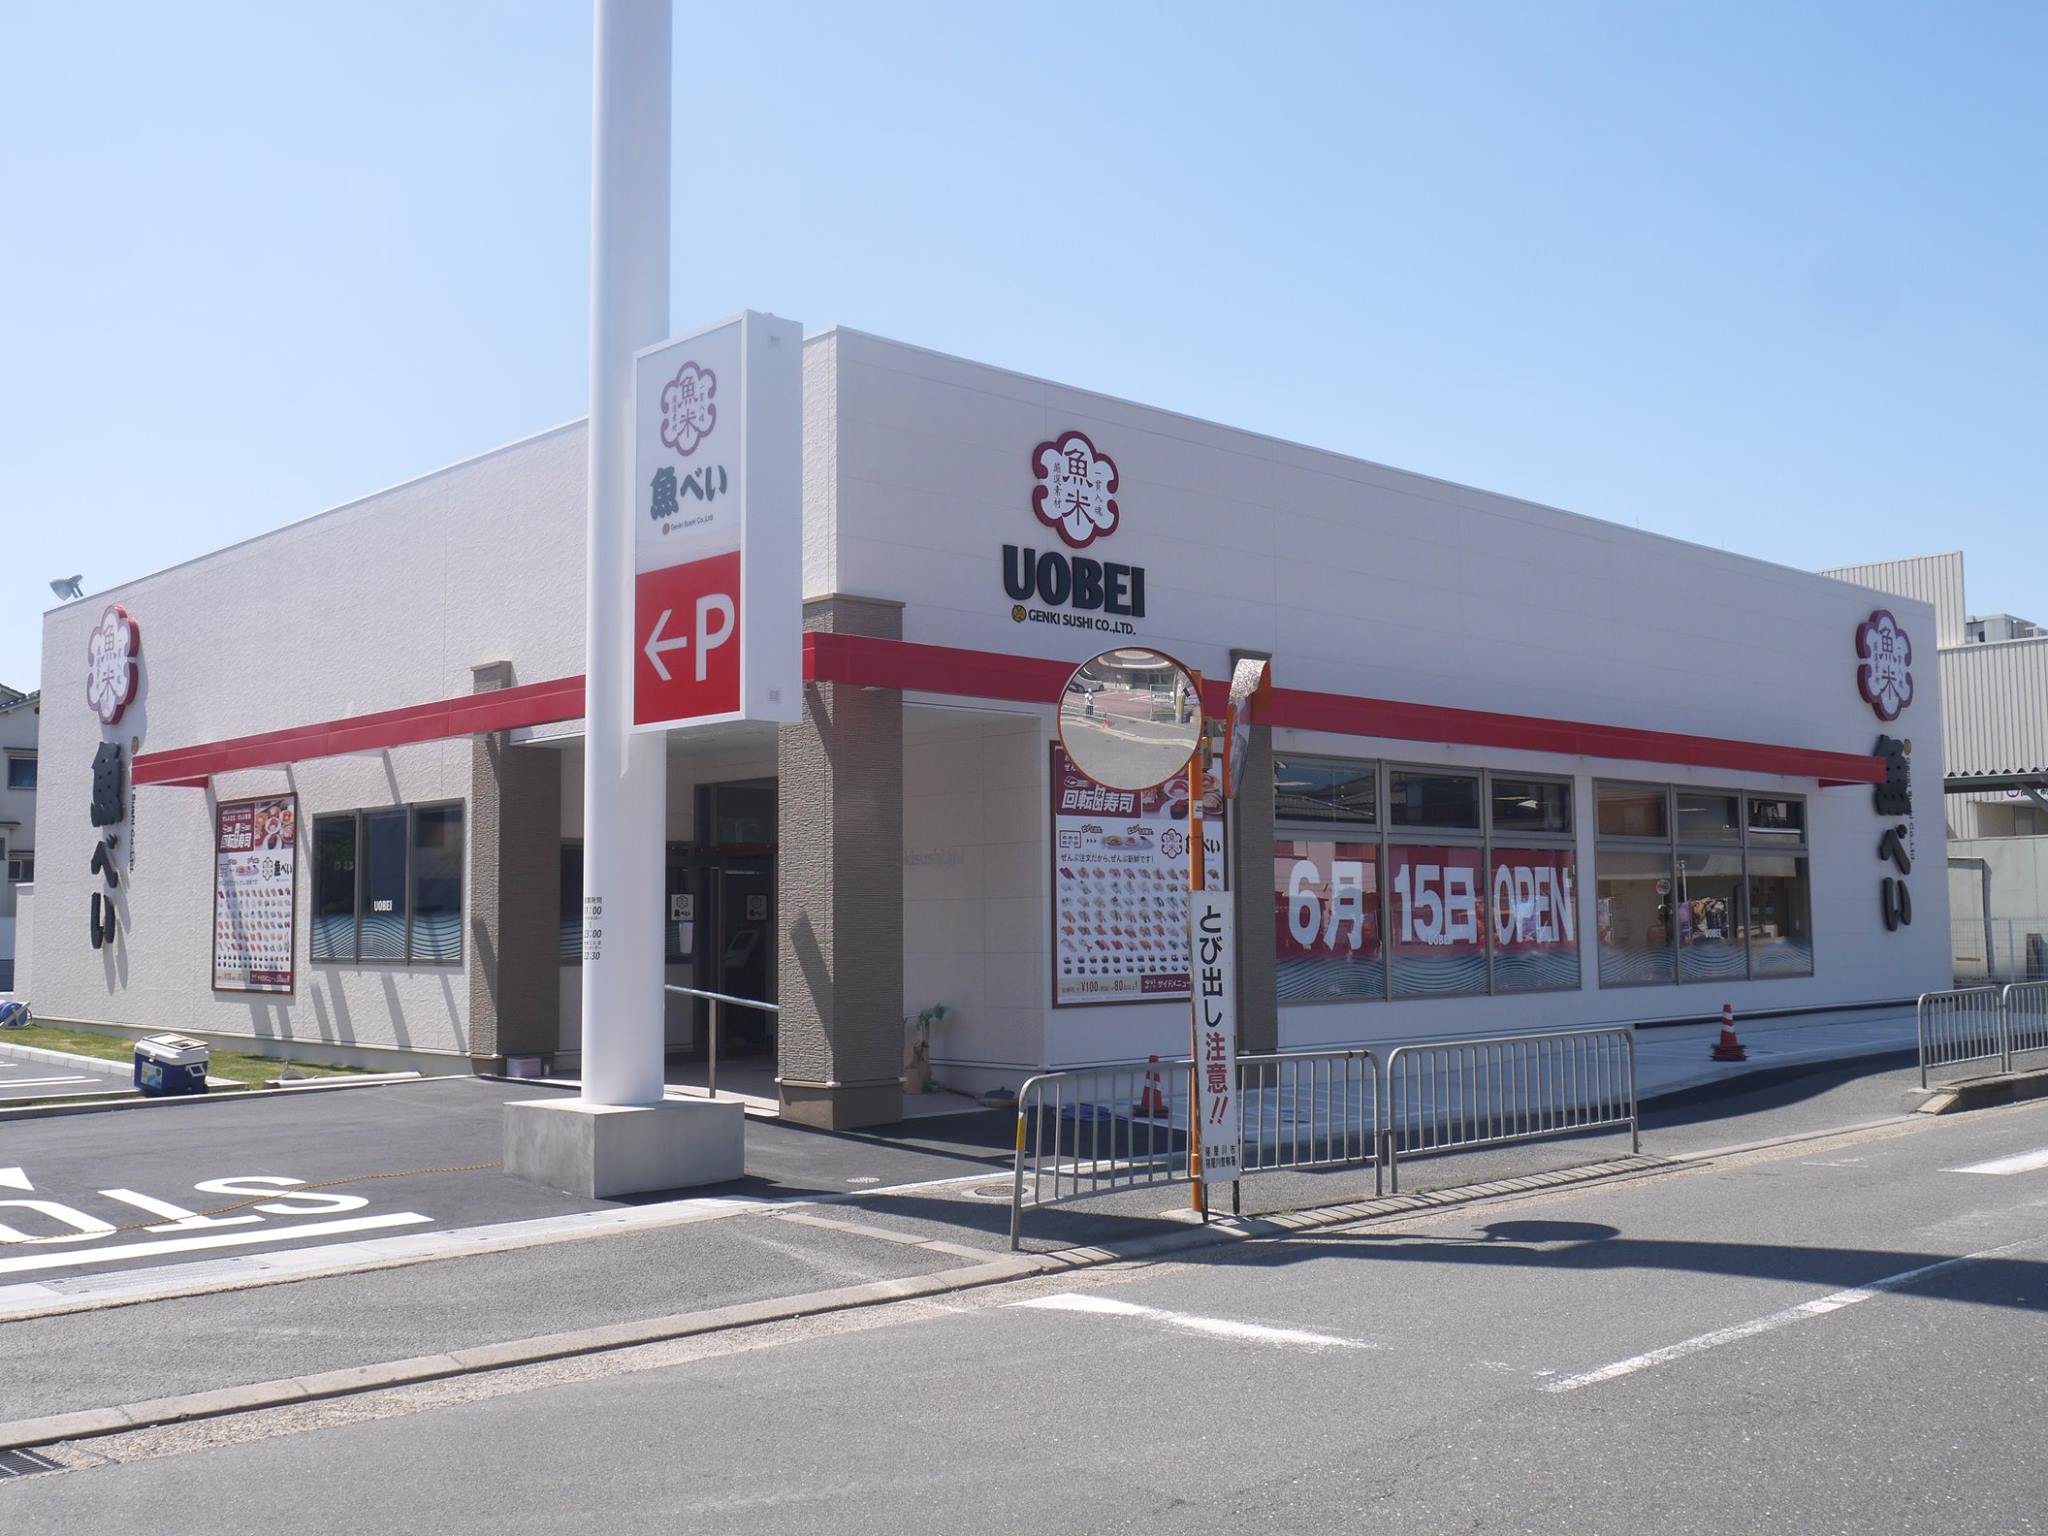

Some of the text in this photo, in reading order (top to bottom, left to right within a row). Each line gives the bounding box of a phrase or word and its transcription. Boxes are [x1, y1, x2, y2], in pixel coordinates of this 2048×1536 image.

[650, 464, 728, 521] 魚べい
[1061, 448, 1095, 527] 魚米
[1002, 544, 1146, 618] UOBEI
[1028, 608, 1061, 626] GENKI
[1062, 613, 1094, 631] SUSHI
[695, 593, 736, 682] P
[91, 741, 124, 950] 魚べい
[1873, 734, 1912, 932] 魚べい
[373, 899, 392, 912] UOBEI
[1287, 859, 1575, 951] 6月 15日 OPEN
